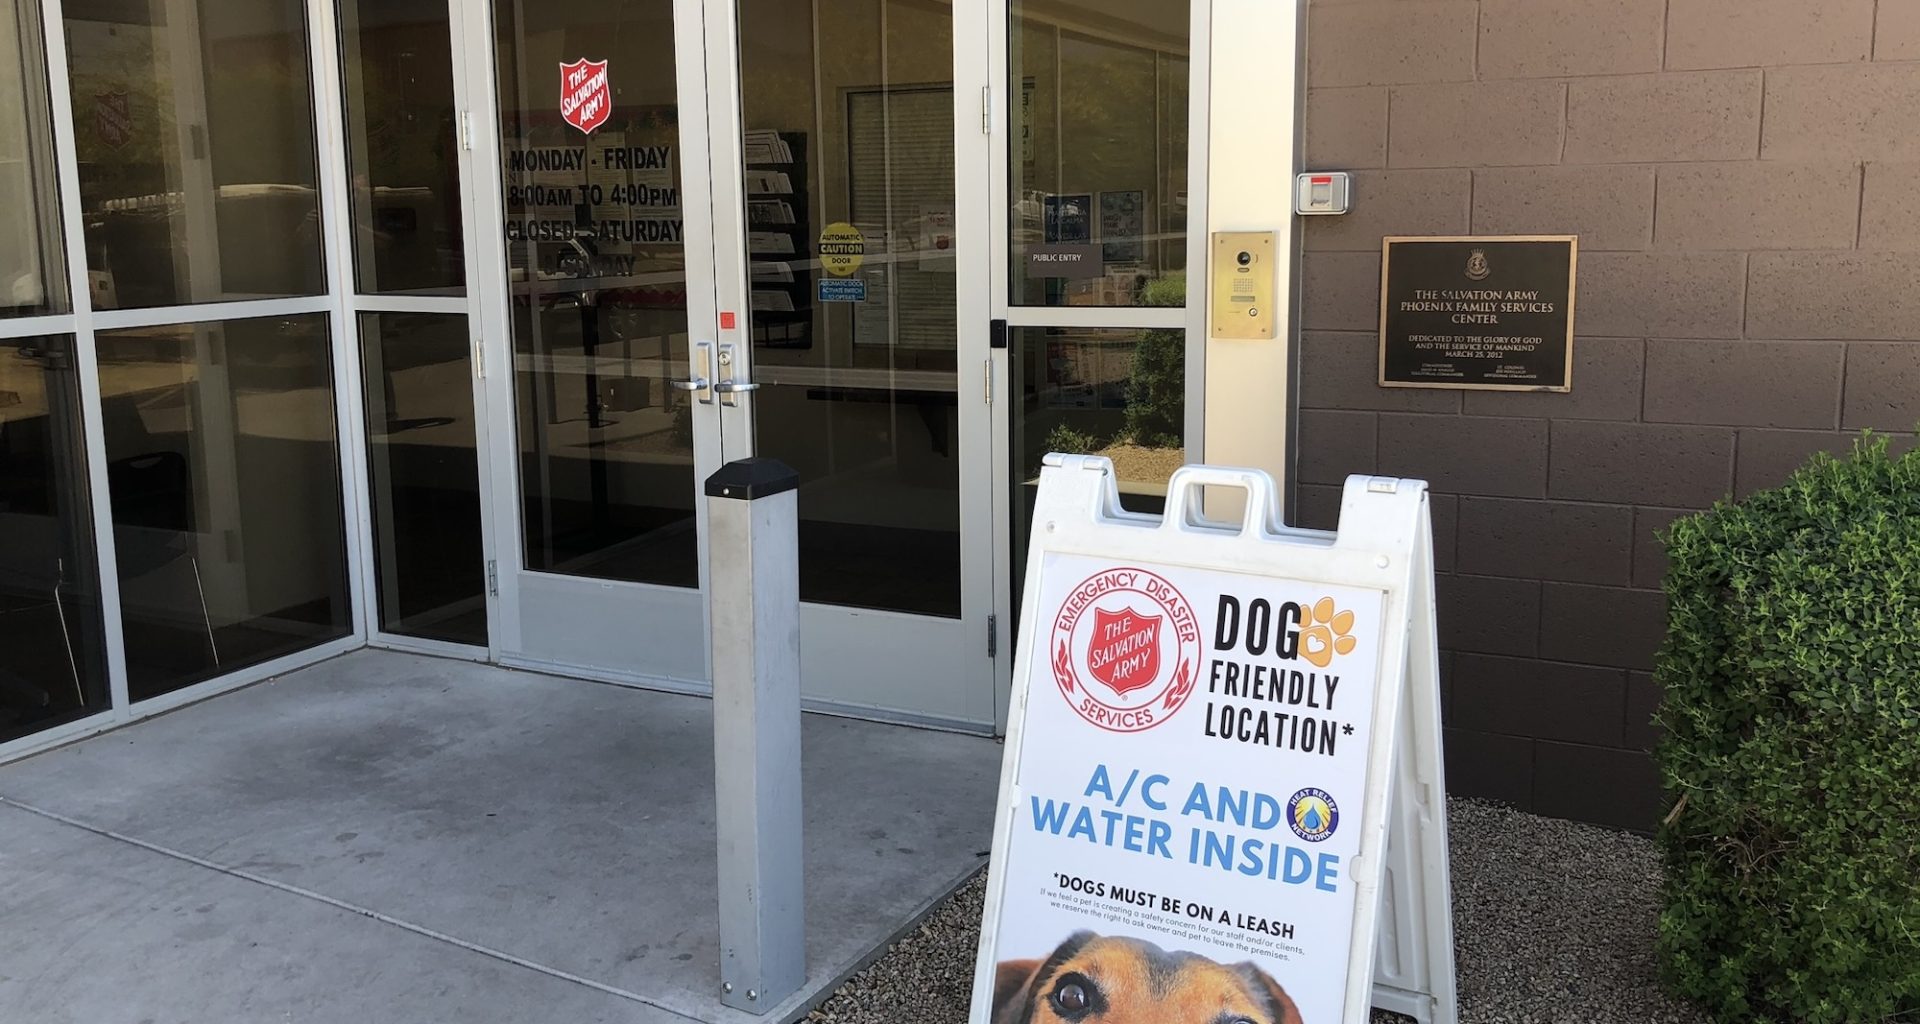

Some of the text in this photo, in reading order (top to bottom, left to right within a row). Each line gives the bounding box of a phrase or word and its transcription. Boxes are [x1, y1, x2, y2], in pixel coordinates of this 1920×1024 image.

[564, 67, 605, 116] SALVATION
[569, 65, 587, 89] THE
[580, 89, 604, 126] ARMY
[510, 149, 584, 171] MONDAY
[604, 147, 669, 169] FRIDAY
[510, 184, 677, 206] 8:00AM TO 4:00PM
[506, 220, 682, 241] CLOSED SATURDAY
[820, 244, 862, 253] CAUTION
[1401, 302, 1553, 312] PHOENIX FAMILY SERVICES
[1415, 290, 1538, 300] THE SALVATION ARMY
[1452, 314, 1498, 324] CENTER
[1059, 573, 1195, 644] EMERGENCY DISASTER
[1104, 617, 1132, 642] THE
[1214, 594, 1302, 660] DOG
[1092, 624, 1155, 669] SALVATION
[1111, 648, 1150, 682] ARMY
[1209, 660, 1340, 710] FRIENDLY
[1080, 698, 1154, 728] SERVICES
[1084, 764, 1281, 830] A/C AND
[1290, 789, 1337, 813] HEAT RELIEF
[1031, 796, 1340, 892] WATER INSIDE
[1292, 823, 1332, 841] NETWORK
[1059, 892, 1072, 901] feel
[1101, 903, 1132, 917] creating
[1141, 912, 1164, 923] safety
[1166, 918, 1196, 930] concern
[1198, 923, 1209, 932] for
[1211, 928, 1224, 936] our
[1226, 931, 1244, 941] staff
[1246, 936, 1274, 947] and/or
[1276, 942, 1305, 955] clients,
[1110, 885, 1156, 908] MUST
[1162, 898, 1180, 914] BE
[1186, 903, 1213, 922] ON
[1219, 910, 1231, 926] A
[1238, 914, 1294, 939] LEASH
[1062, 904, 1089, 915] reserve
[1090, 909, 1102, 918] the
[1104, 913, 1121, 922] right
[1132, 920, 1144, 928] ask
[1147, 923, 1170, 933] owner
[1172, 928, 1187, 937] and
[1213, 937, 1234, 948] leave
[1236, 942, 1248, 951] the
[1250, 947, 1290, 961] premises.
